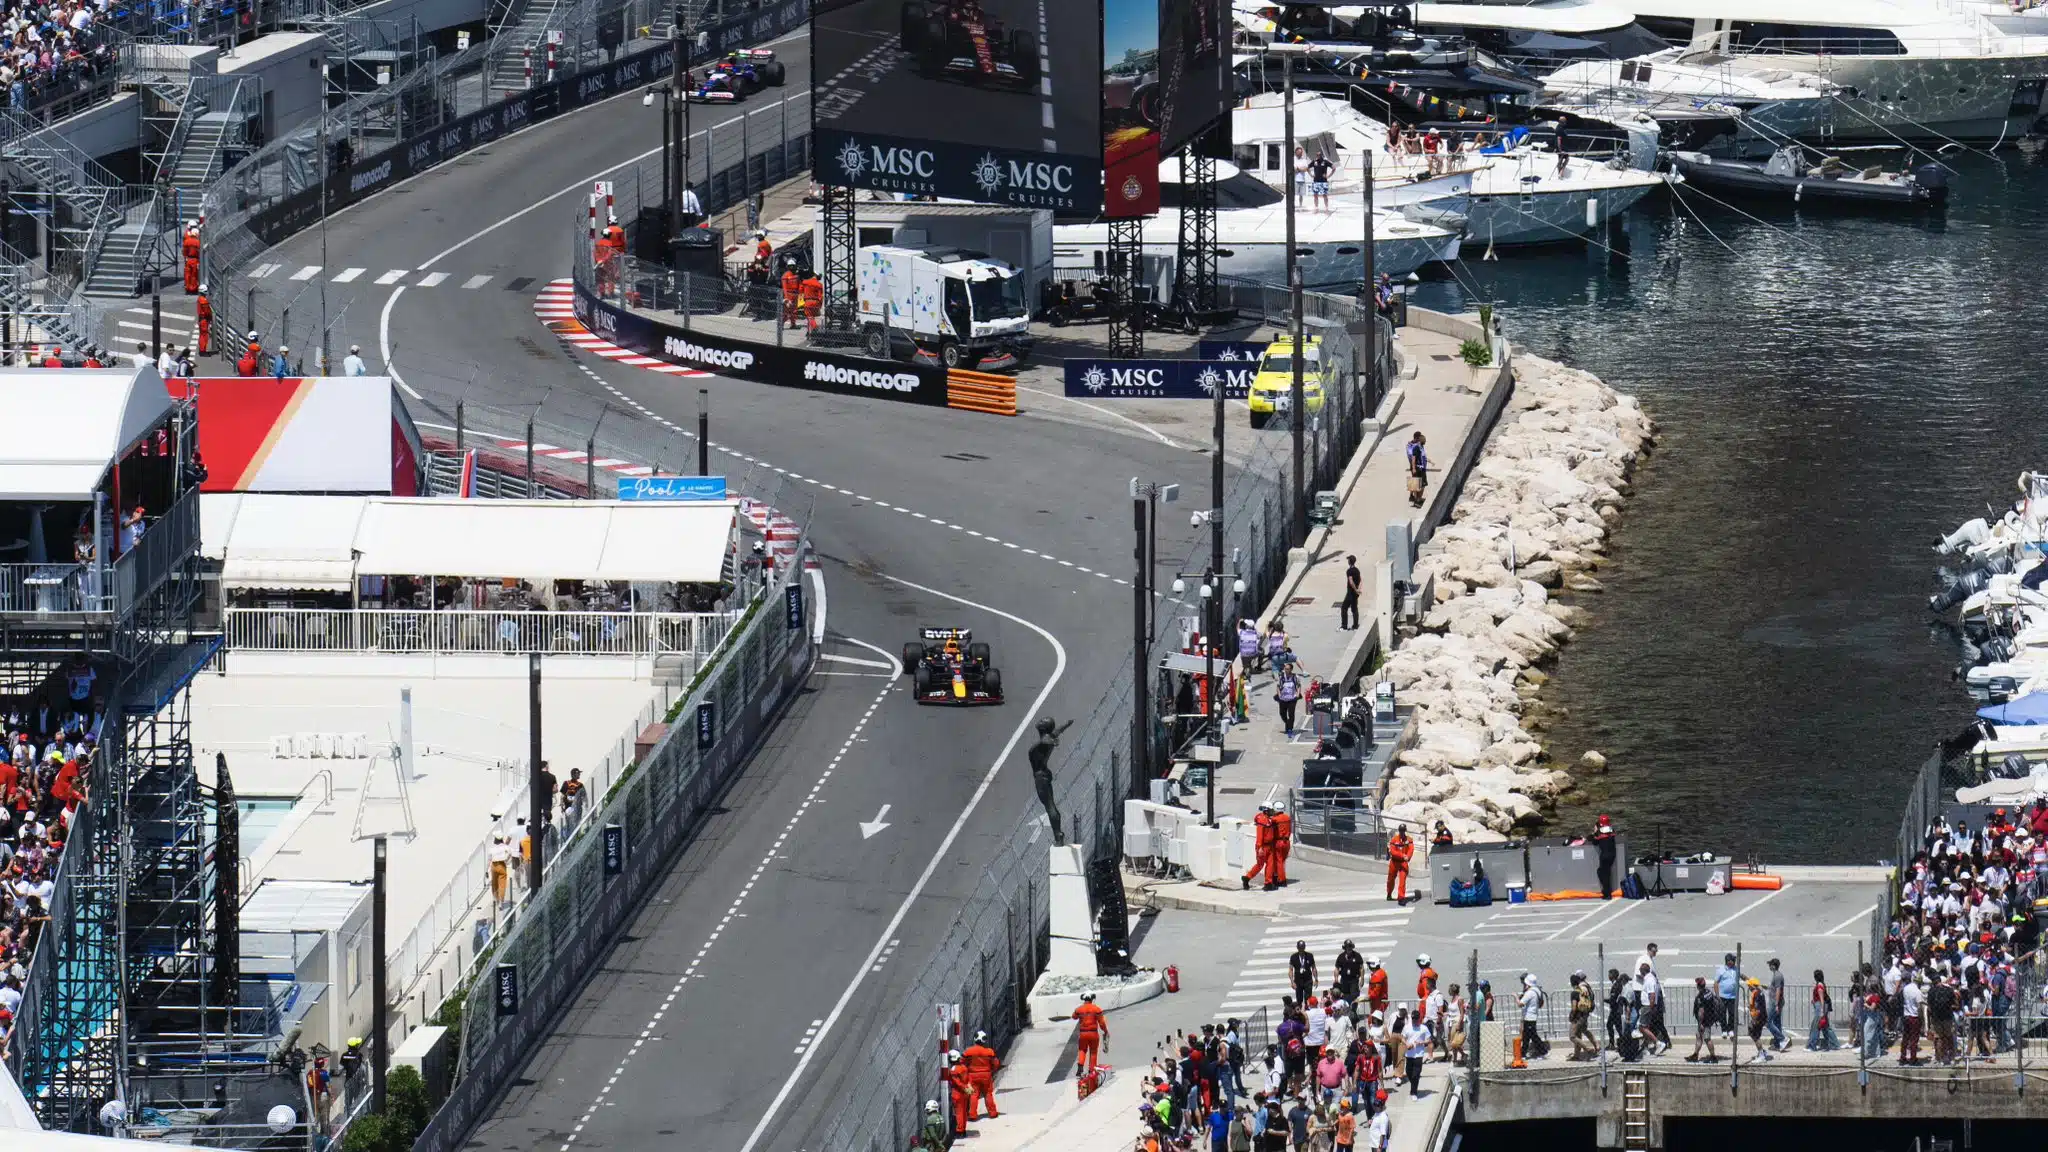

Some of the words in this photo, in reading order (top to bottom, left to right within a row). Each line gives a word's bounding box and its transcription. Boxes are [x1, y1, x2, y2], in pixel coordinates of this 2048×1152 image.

[623, 61, 641, 81] MSC
[588, 73, 605, 94] MSC
[511, 100, 527, 121] MSC
[479, 113, 495, 134] MSC
[446, 127, 463, 148] MSC
[871, 145, 935, 178] MSC
[871, 177, 935, 192] CRUISES
[1008, 160, 1073, 193] MSC
[1008, 192, 1074, 208] CRUISES
[600, 309, 617, 332] MSC
[664, 335, 754, 370] #MonacoGP
[804, 361, 920, 392] #MonacoGP
[1111, 368, 1164, 387] MSC
[1225, 369, 1255, 387] MS
[634, 478, 676, 499] Pool
[701, 709, 709, 731] MSC
[608, 833, 616, 857] MSC
[501, 971, 510, 996] MSC
